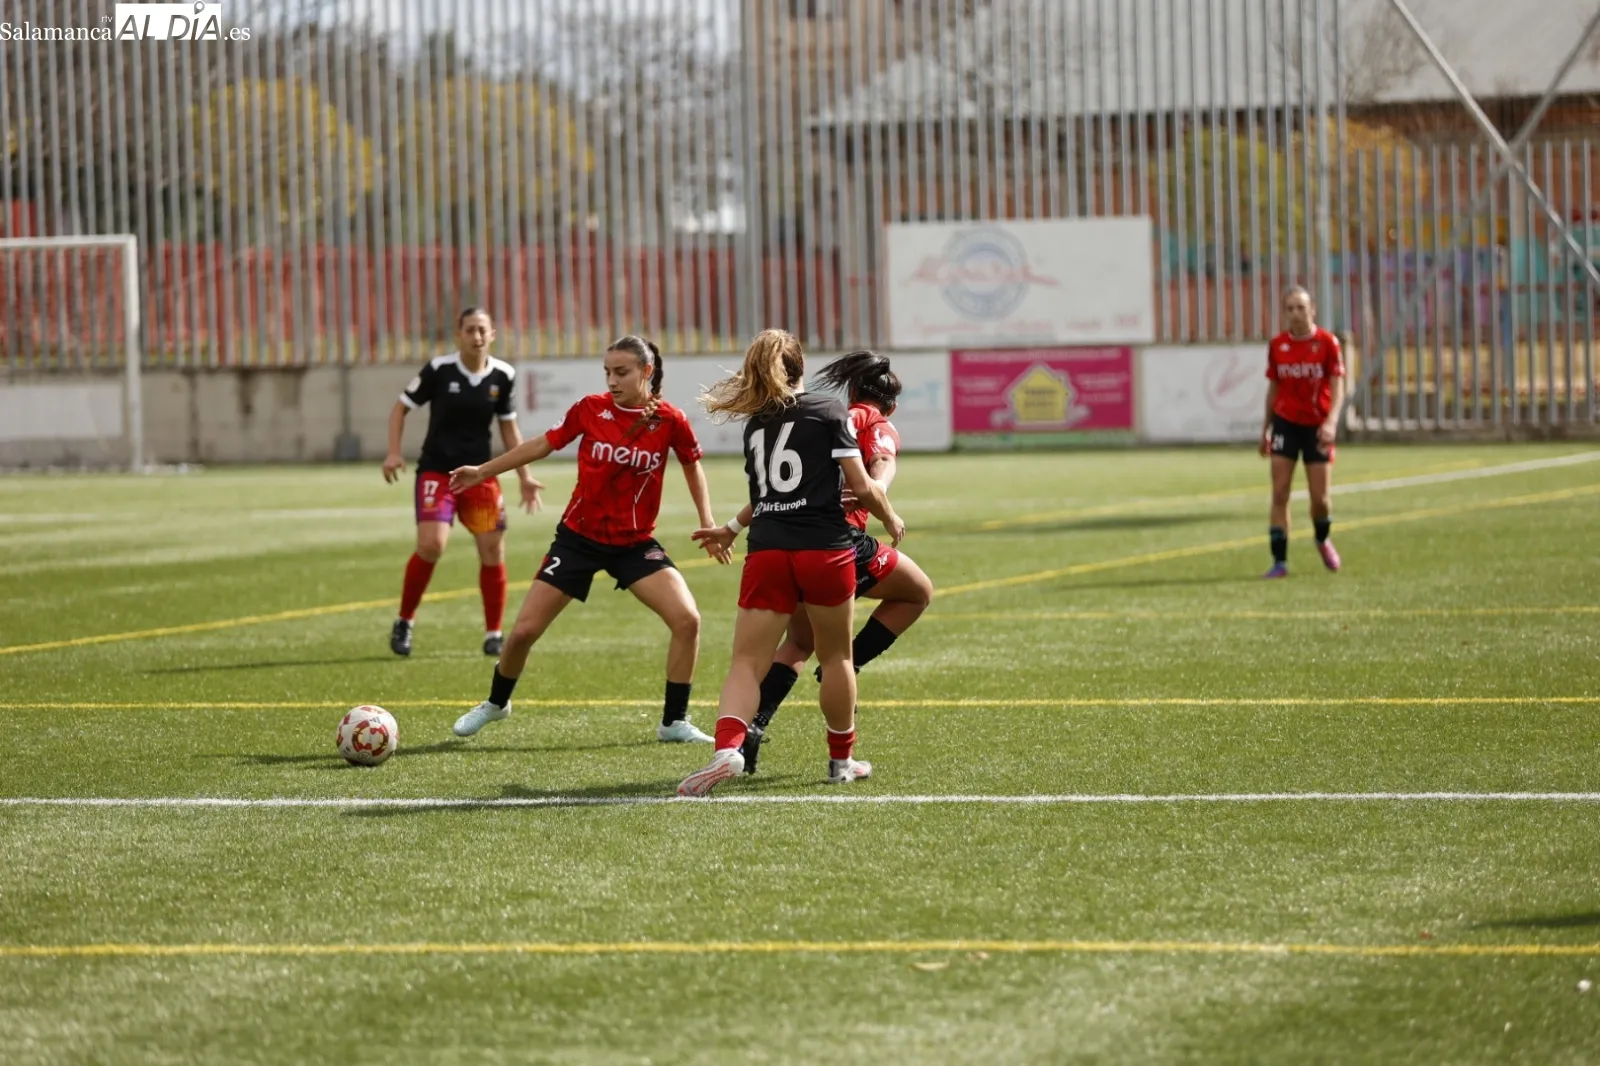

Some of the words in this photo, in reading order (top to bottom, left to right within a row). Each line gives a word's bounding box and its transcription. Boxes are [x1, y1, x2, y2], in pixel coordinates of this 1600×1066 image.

[592, 440, 662, 469] meins
[748, 421, 803, 498] 16
[762, 498, 807, 513] AirEuropa
[543, 556, 561, 576] 2
